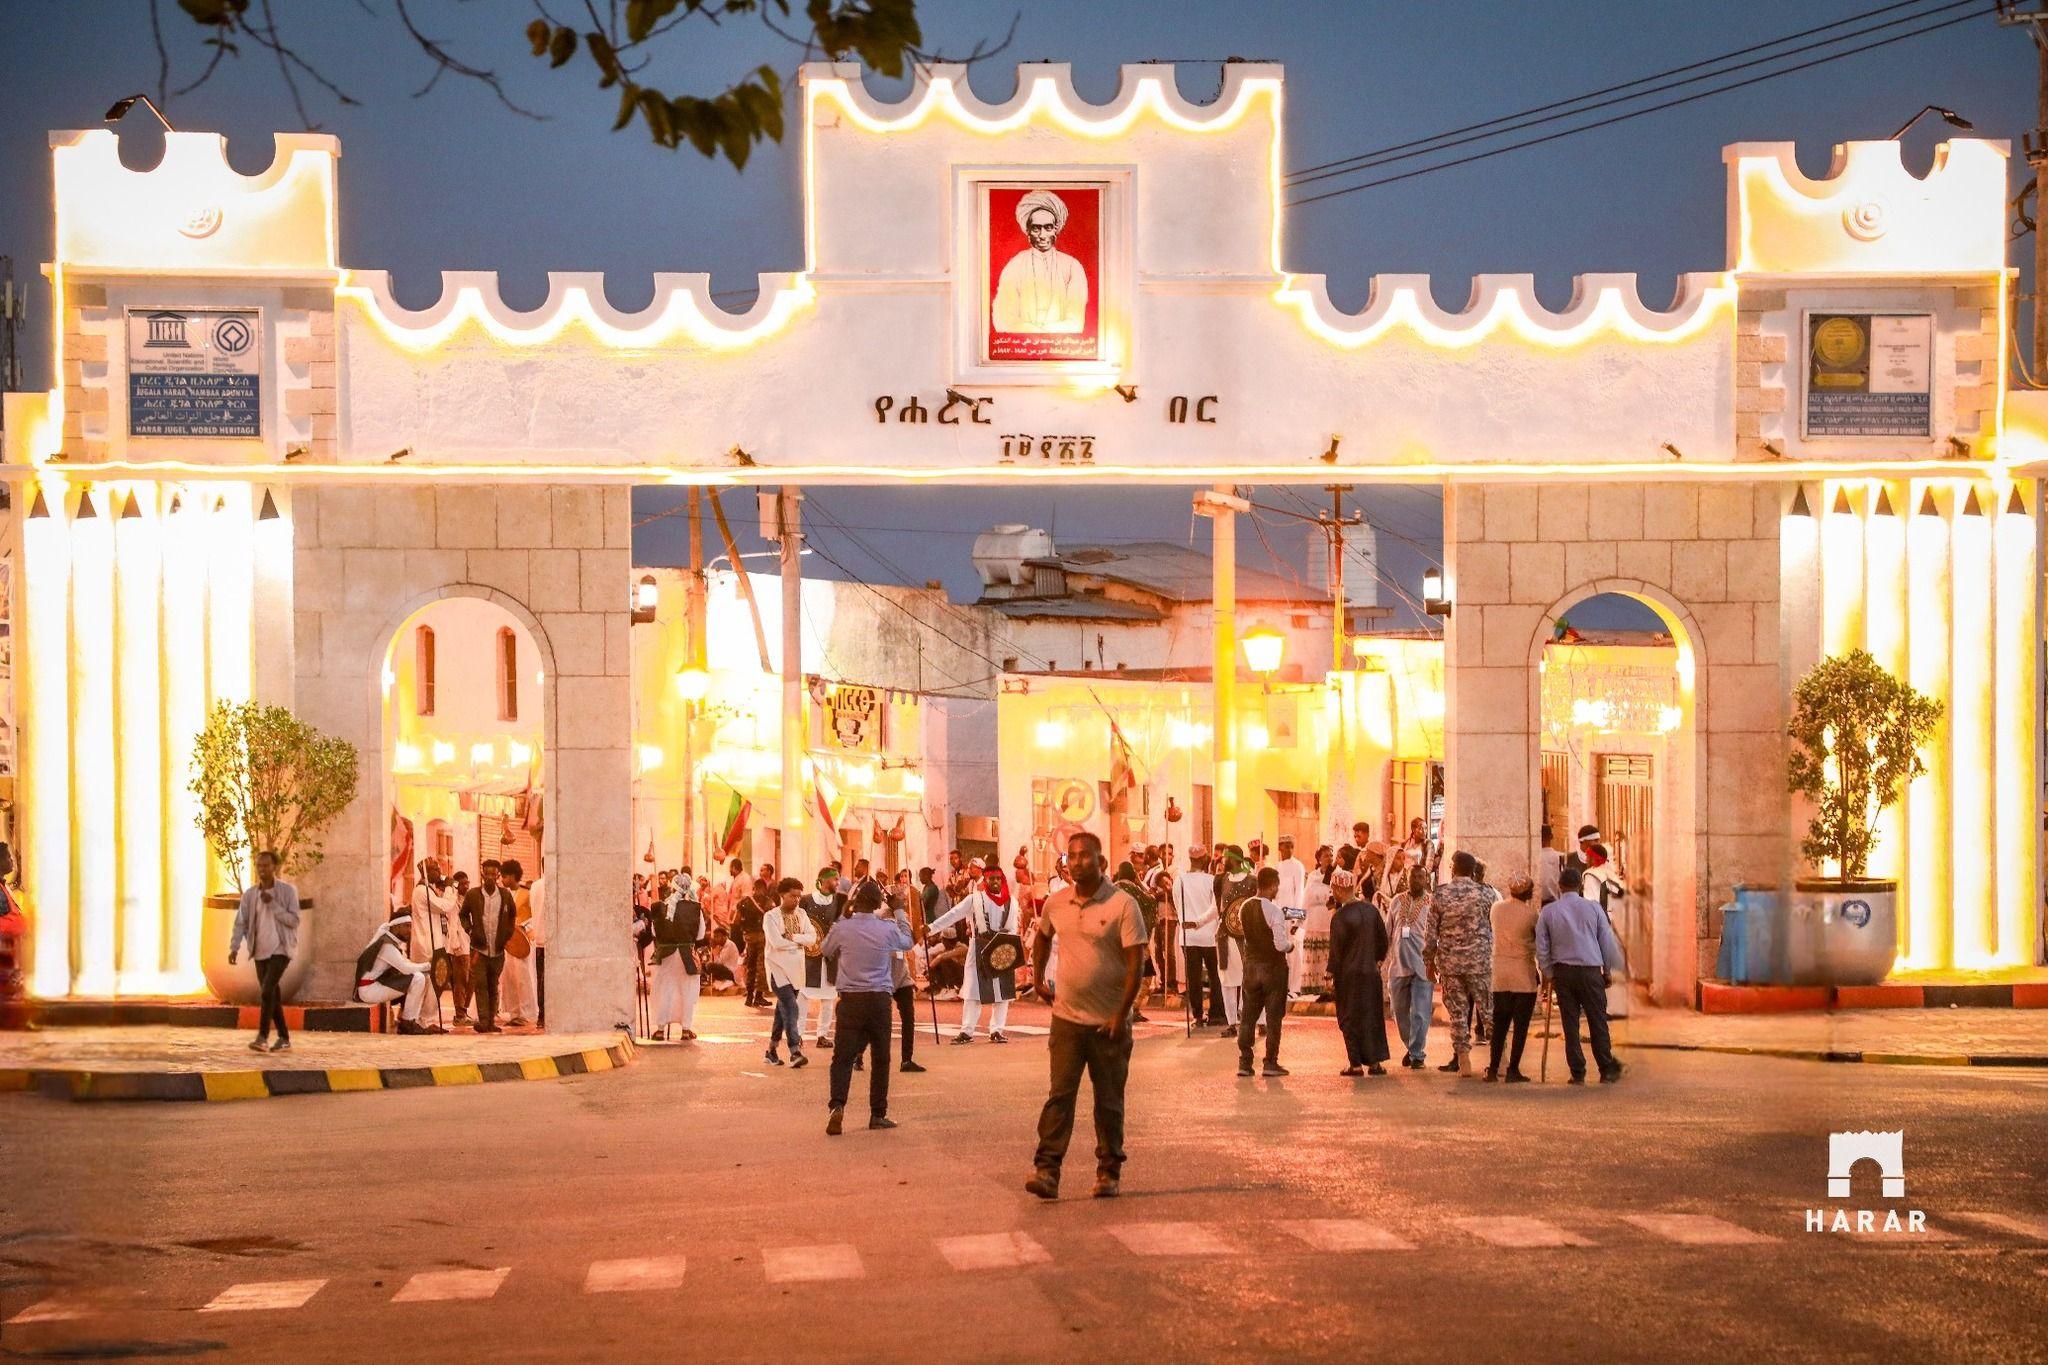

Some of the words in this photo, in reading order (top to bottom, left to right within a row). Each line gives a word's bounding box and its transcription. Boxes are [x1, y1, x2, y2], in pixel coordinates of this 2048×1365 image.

[1169, 395, 1218, 424] በር
[136, 426, 161, 434] HARAR
[191, 426, 217, 435] WORLD
[220, 426, 255, 435] HERITAGE
